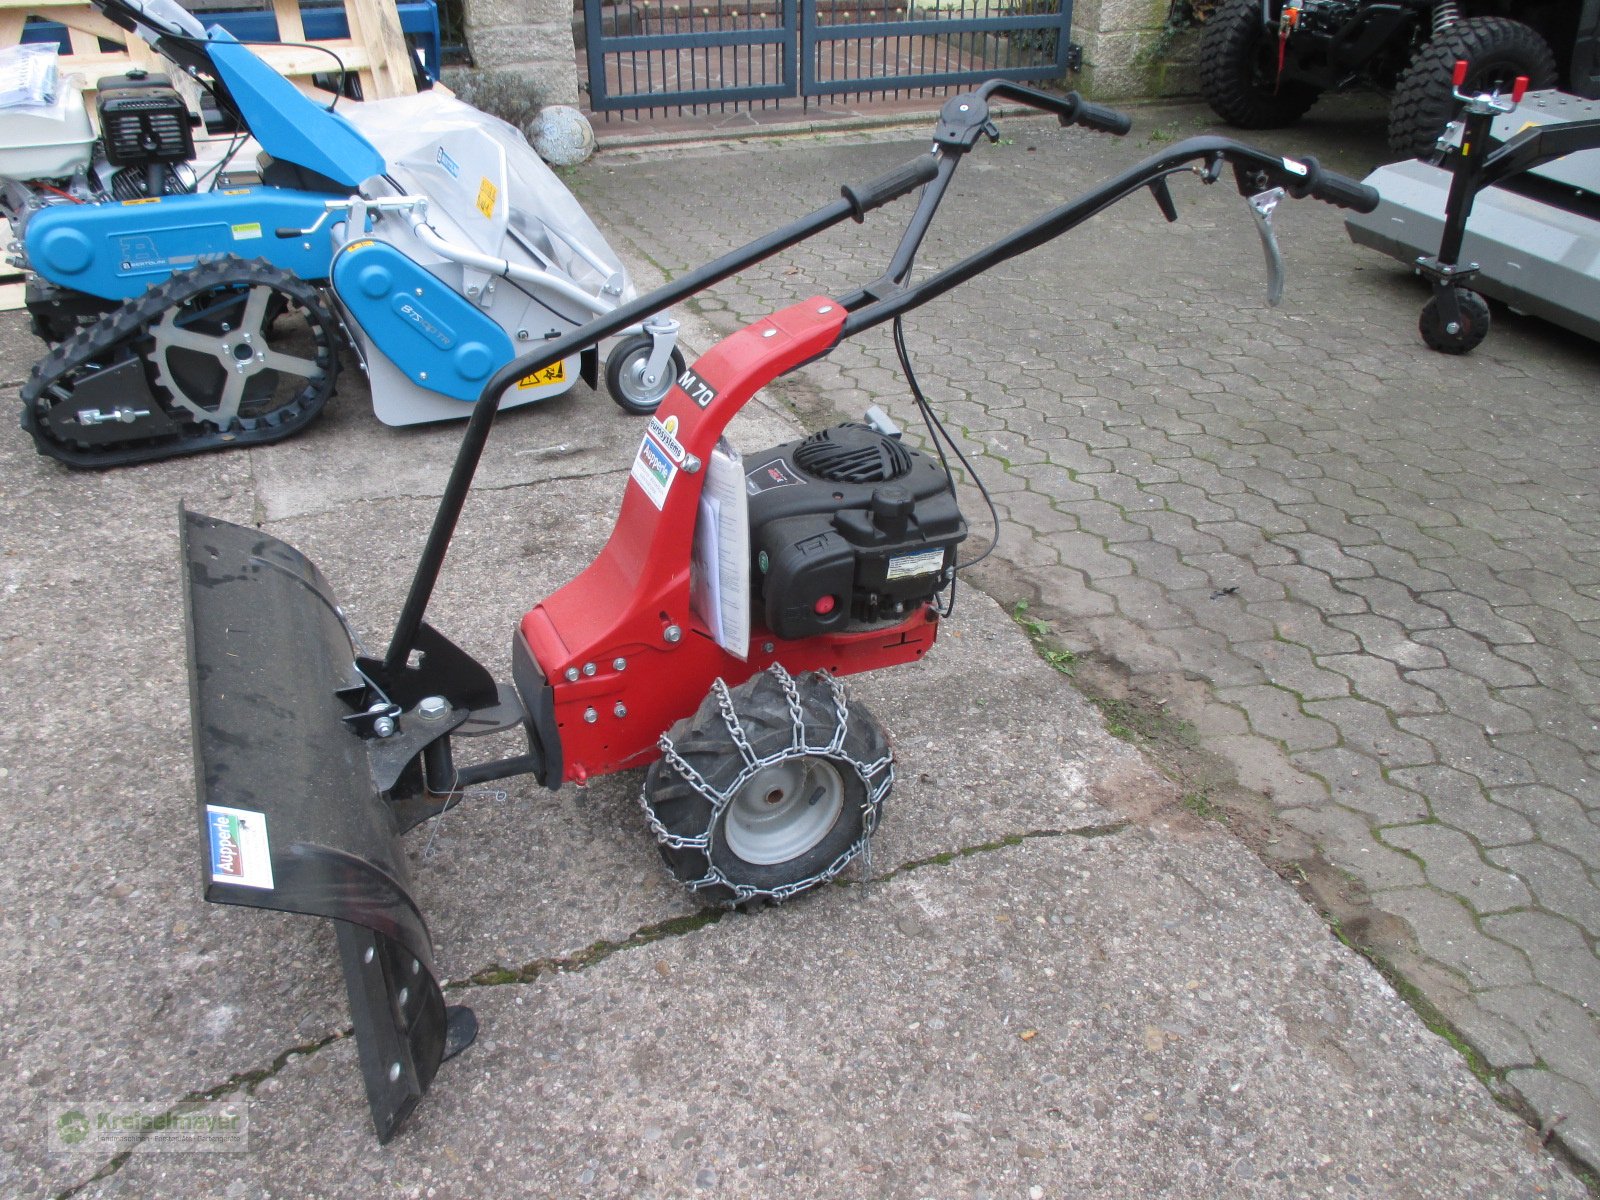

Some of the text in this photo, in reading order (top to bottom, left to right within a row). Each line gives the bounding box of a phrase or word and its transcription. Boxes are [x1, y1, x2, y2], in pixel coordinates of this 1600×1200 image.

[678, 370, 715, 407] M 70
[650, 420, 682, 458] eurosystems
[643, 444, 670, 479] Aupperle
[212, 815, 237, 873] Aupperle
